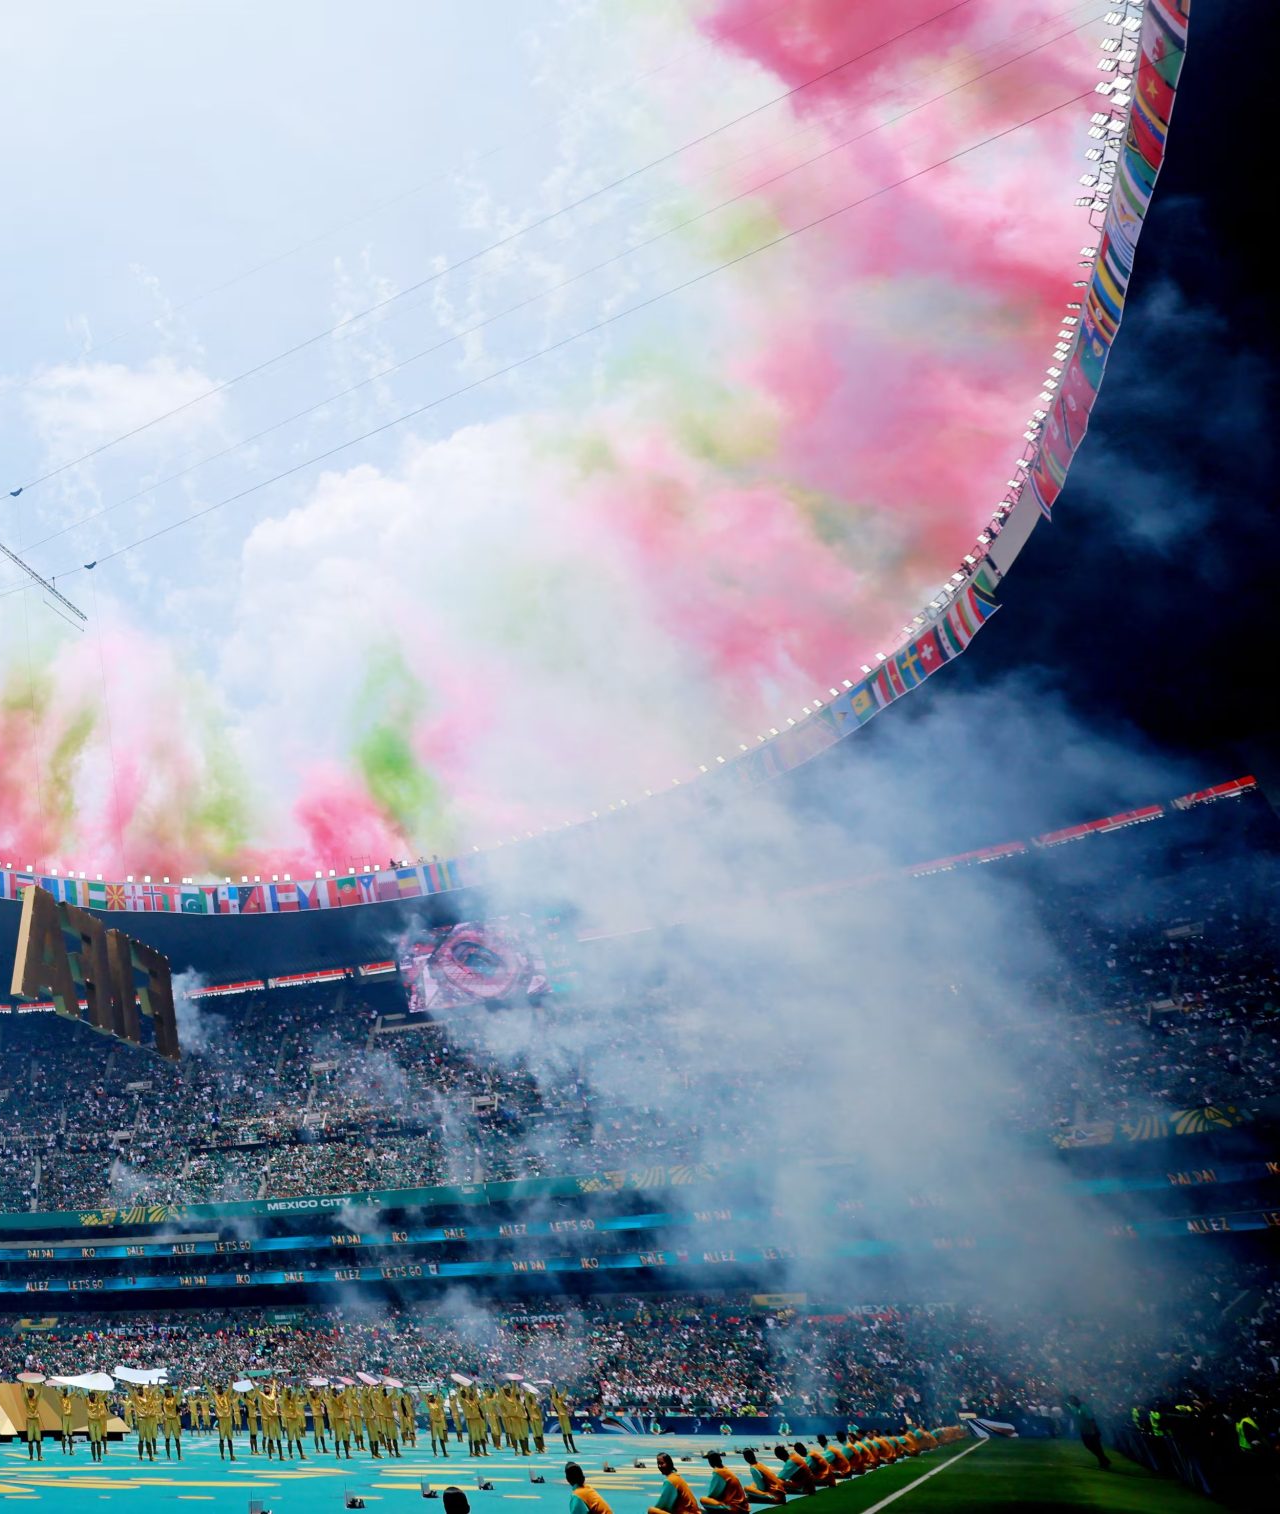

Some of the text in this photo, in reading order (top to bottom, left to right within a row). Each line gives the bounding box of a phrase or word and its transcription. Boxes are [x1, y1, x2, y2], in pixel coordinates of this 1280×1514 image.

[267, 1198, 351, 1211] MEXICO CITY
[1187, 1217, 1231, 1233] ALLEZ
[443, 1228, 466, 1239] DALE
[127, 1246, 144, 1256] DALE
[172, 1244, 195, 1255] ALLEZ
[215, 1241, 238, 1252] LET'S
[240, 1240, 251, 1251] GO
[284, 1272, 304, 1282] DALE
[335, 1270, 361, 1281] ALLEZ
[381, 1267, 406, 1279] LET'S
[409, 1266, 422, 1276] GO
[26, 1281, 49, 1292] ALLEZ
[68, 1280, 90, 1290] LET'S
[93, 1279, 104, 1289] GO
